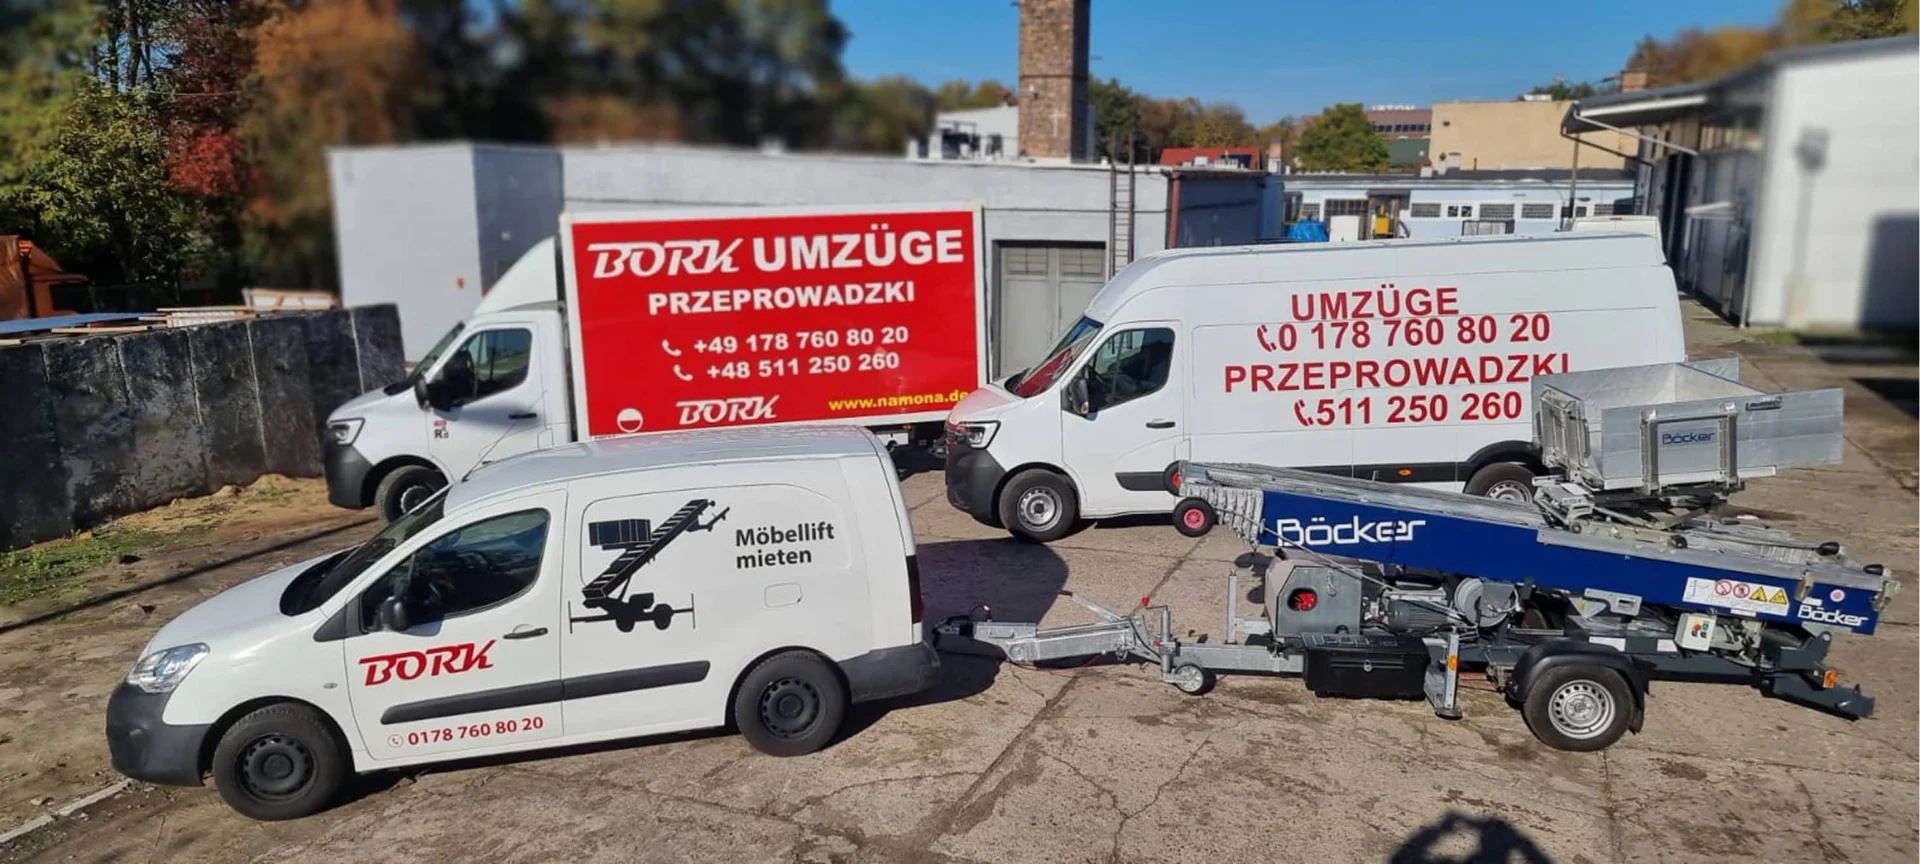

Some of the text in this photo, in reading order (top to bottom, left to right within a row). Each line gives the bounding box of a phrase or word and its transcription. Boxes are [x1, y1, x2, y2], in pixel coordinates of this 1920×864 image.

[588, 223, 964, 279] BORK UMZÜGE
[648, 281, 915, 315] PRZEPROWADZKI
[1291, 284, 1460, 321] UMZÜGE
[694, 326, 910, 354] +49 178 760 80 20
[1278, 313, 1551, 351] 0 178 760 80 20
[707, 352, 900, 379] +48 511 250 260
[1224, 352, 1569, 393] PRZEPROWADZKI
[676, 395, 780, 426] BORK
[828, 389, 969, 411] www.namona.de
[1316, 390, 1523, 426] 511 250 260
[1661, 431, 1716, 445] Böcker
[735, 521, 835, 547] Möbellift
[1275, 515, 1427, 548] Böcker
[736, 549, 812, 570] mieten
[1797, 604, 1870, 627] Böcker
[358, 639, 497, 687] BORK
[407, 716, 544, 746] 0178 760 80 20
